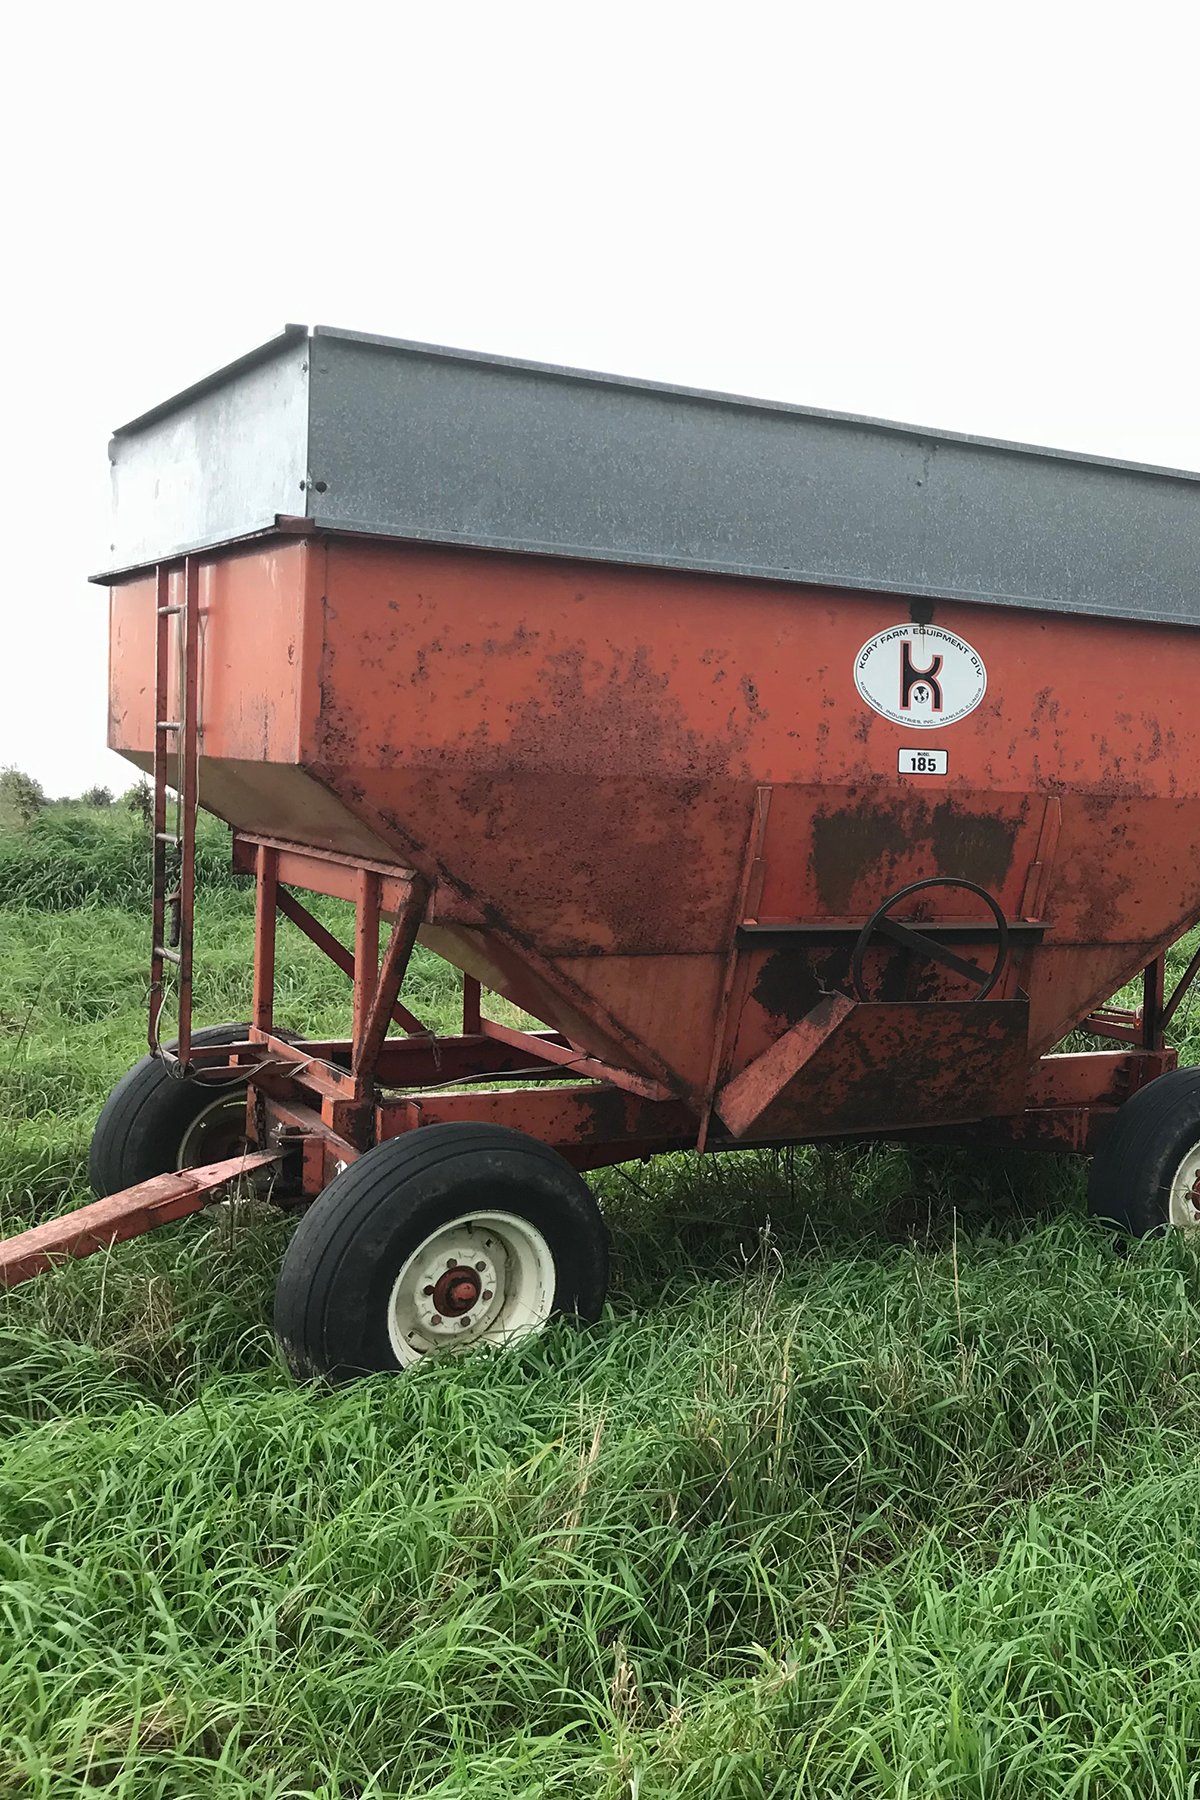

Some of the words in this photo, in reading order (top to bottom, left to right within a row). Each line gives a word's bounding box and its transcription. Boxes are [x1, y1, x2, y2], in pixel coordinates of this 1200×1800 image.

[859, 642, 878, 669] KORY
[880, 629, 908, 644] FARM
[913, 628, 969, 655] EQUIPMENT
[970, 656, 982, 678] DIV.
[911, 757, 936, 772] 185
